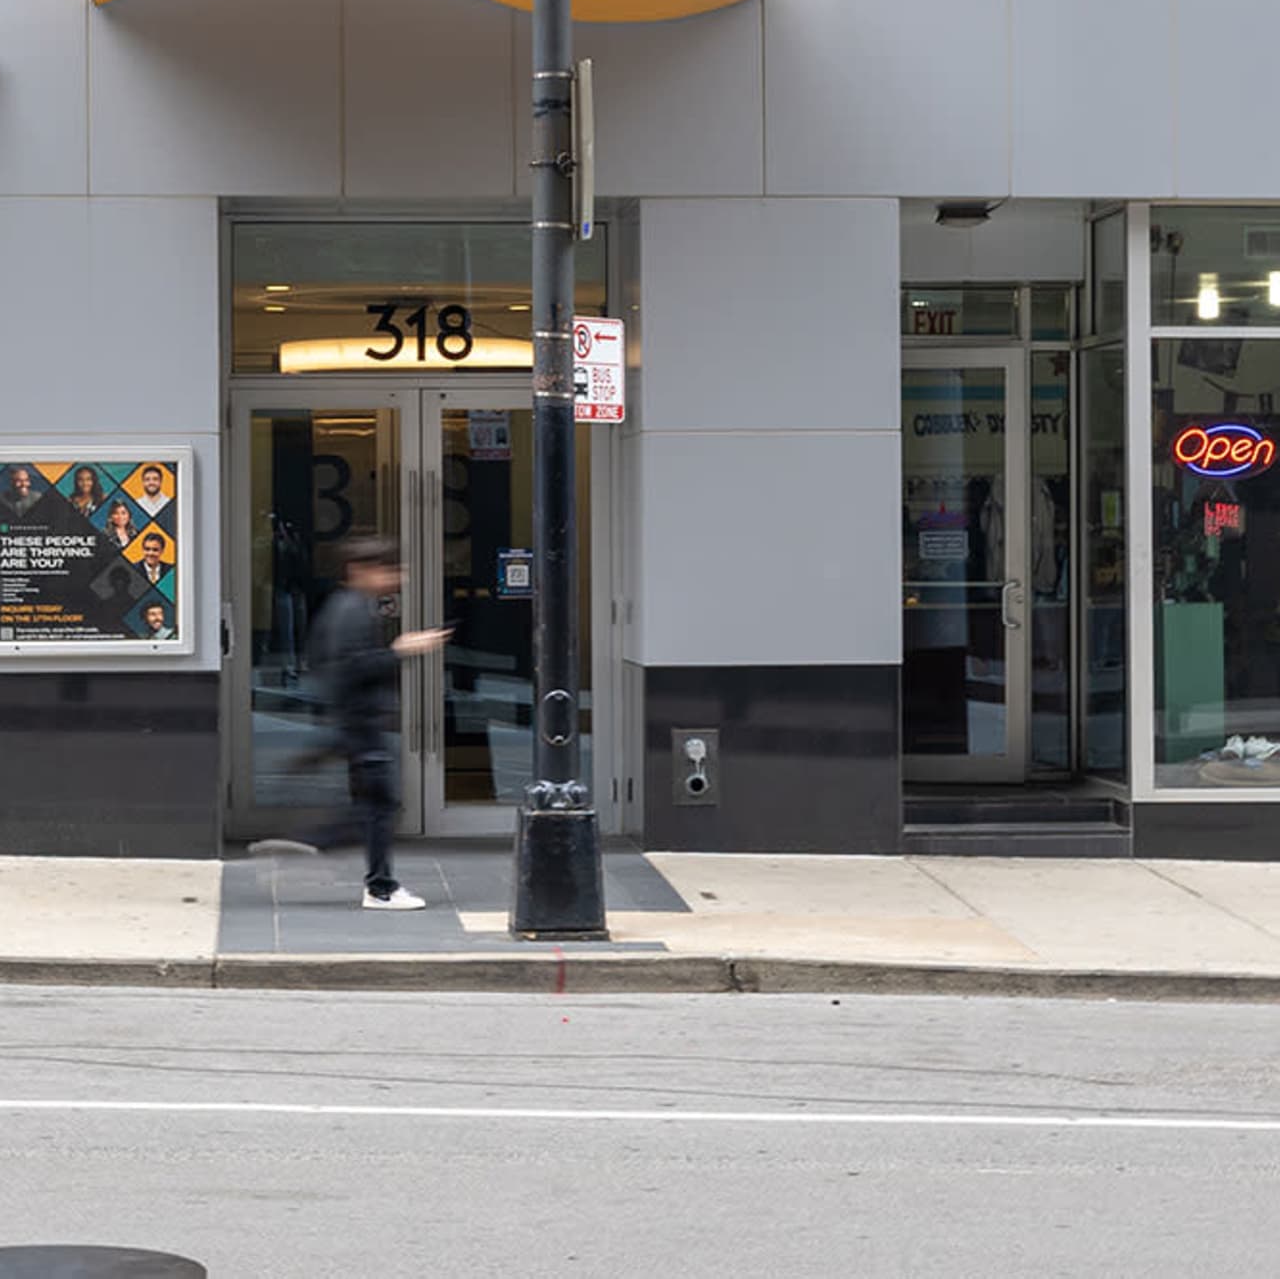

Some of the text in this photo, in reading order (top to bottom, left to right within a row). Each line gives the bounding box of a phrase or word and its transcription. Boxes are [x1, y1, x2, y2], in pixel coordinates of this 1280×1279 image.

[913, 311, 958, 335] EXIT
[365, 305, 473, 361] 318
[592, 367, 611, 384] BUS
[592, 384, 617, 401] STOP
[596, 406, 619, 419] ZONE
[1176, 428, 1275, 468] Open
[1, 536, 96, 546] THESE PEOPLE
[0, 548, 27, 557] ARE
[0, 558, 64, 568] ARE YOU?
